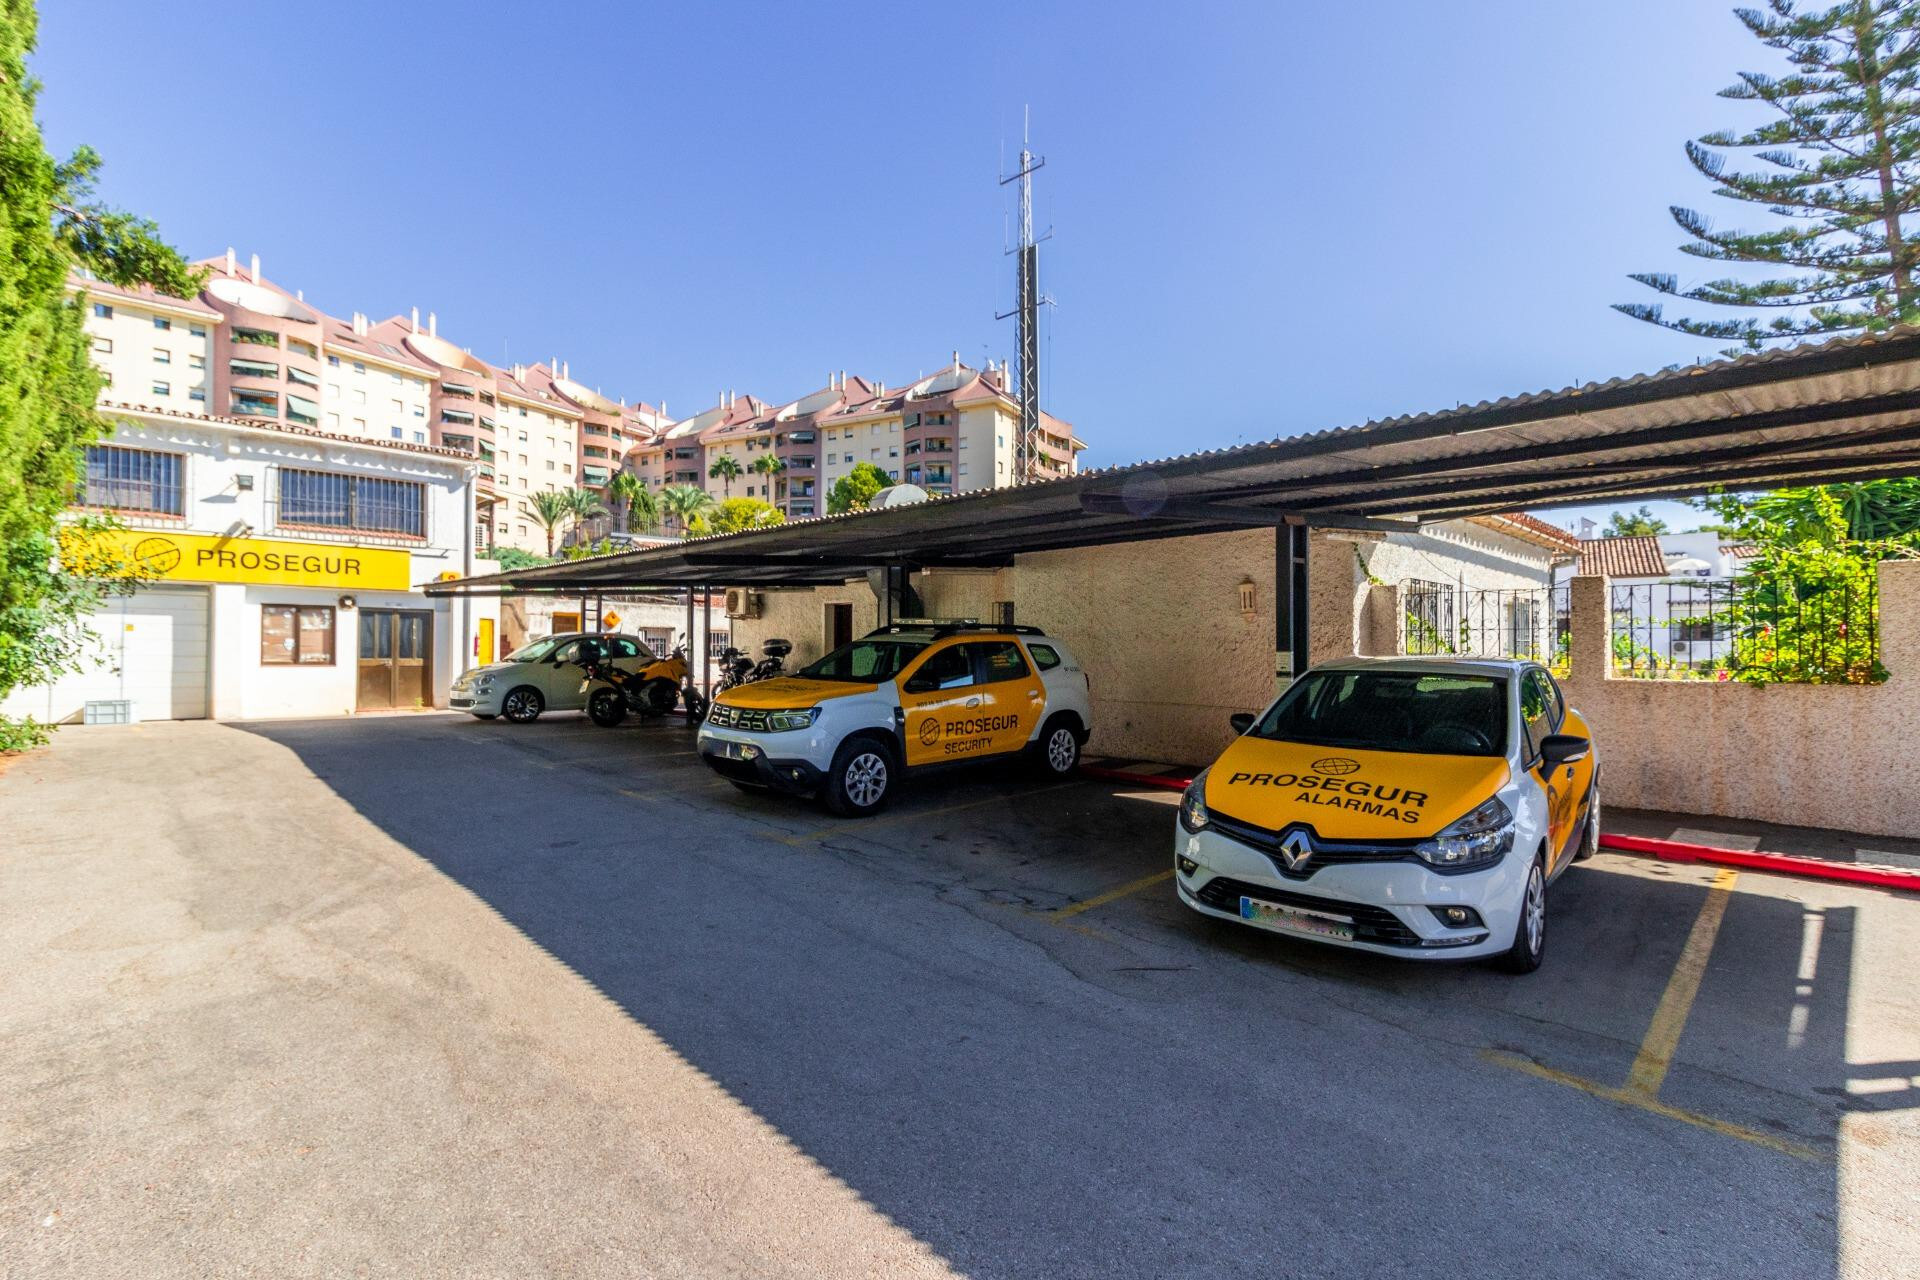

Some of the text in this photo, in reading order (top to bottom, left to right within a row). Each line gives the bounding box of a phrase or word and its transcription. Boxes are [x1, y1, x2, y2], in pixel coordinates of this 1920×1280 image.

[197, 549, 361, 575] PROSEGUR
[945, 715, 1018, 737] PROSEGUR
[944, 738, 993, 754] SECURITY
[1228, 772, 1429, 807] PROSEGUR
[1294, 792, 1420, 824] ALARMAS
